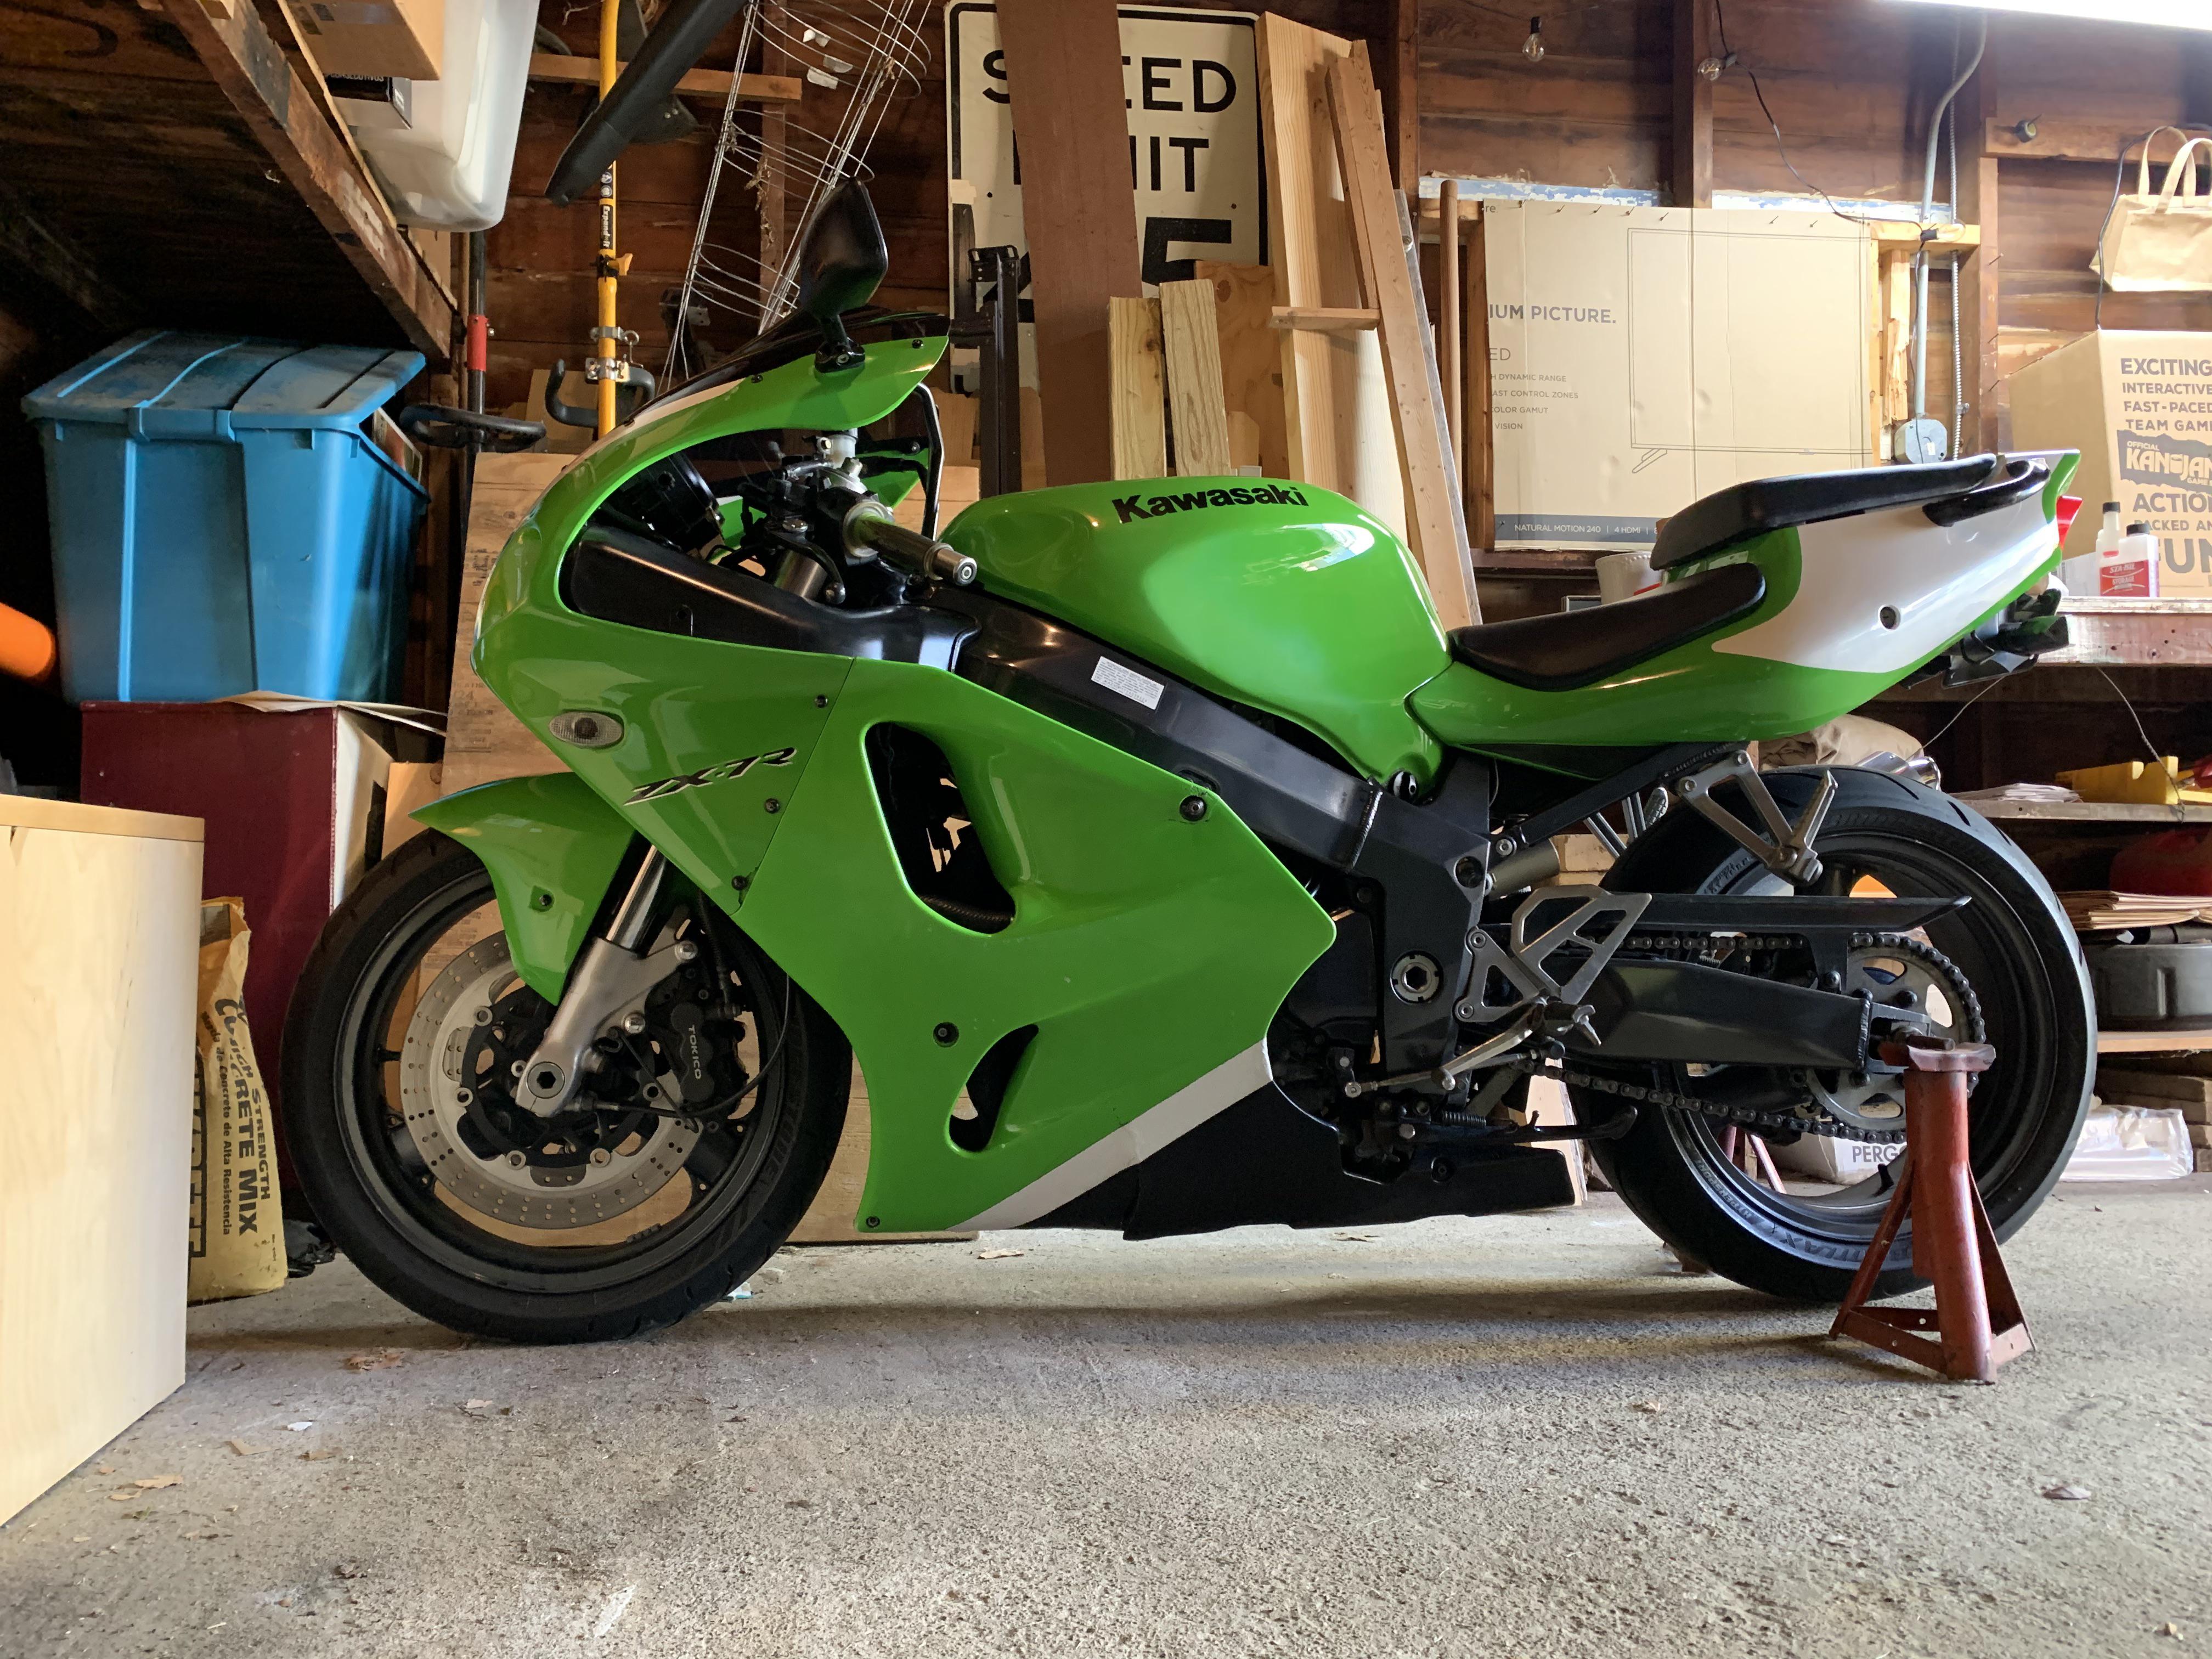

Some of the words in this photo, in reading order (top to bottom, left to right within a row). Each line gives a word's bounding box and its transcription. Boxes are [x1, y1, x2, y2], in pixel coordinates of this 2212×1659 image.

[983, 49, 1237, 113] SED
[1531, 306, 1616, 323] PICTURE.
[2120, 358, 2212, 376] EXCITING
[2122, 382, 2212, 395] INTERACTIVE
[2125, 419, 2168, 431] TEAM
[2174, 420, 2212, 432] GAM
[2126, 441, 2160, 451] OFFICIAL
[1111, 484, 1310, 524] Kawasaki
[689, 1024, 702, 1080] TOKICO
[219, 1065, 232, 1119] Concreto
[223, 1122, 232, 1137] de
[223, 1141, 232, 1165] Alta
[252, 1088, 270, 1200] STRENGTH
[1852, 1145, 1908, 1163] PERG
[223, 1169, 232, 1235] Resistencia
[239, 1169, 258, 1236] MIX
